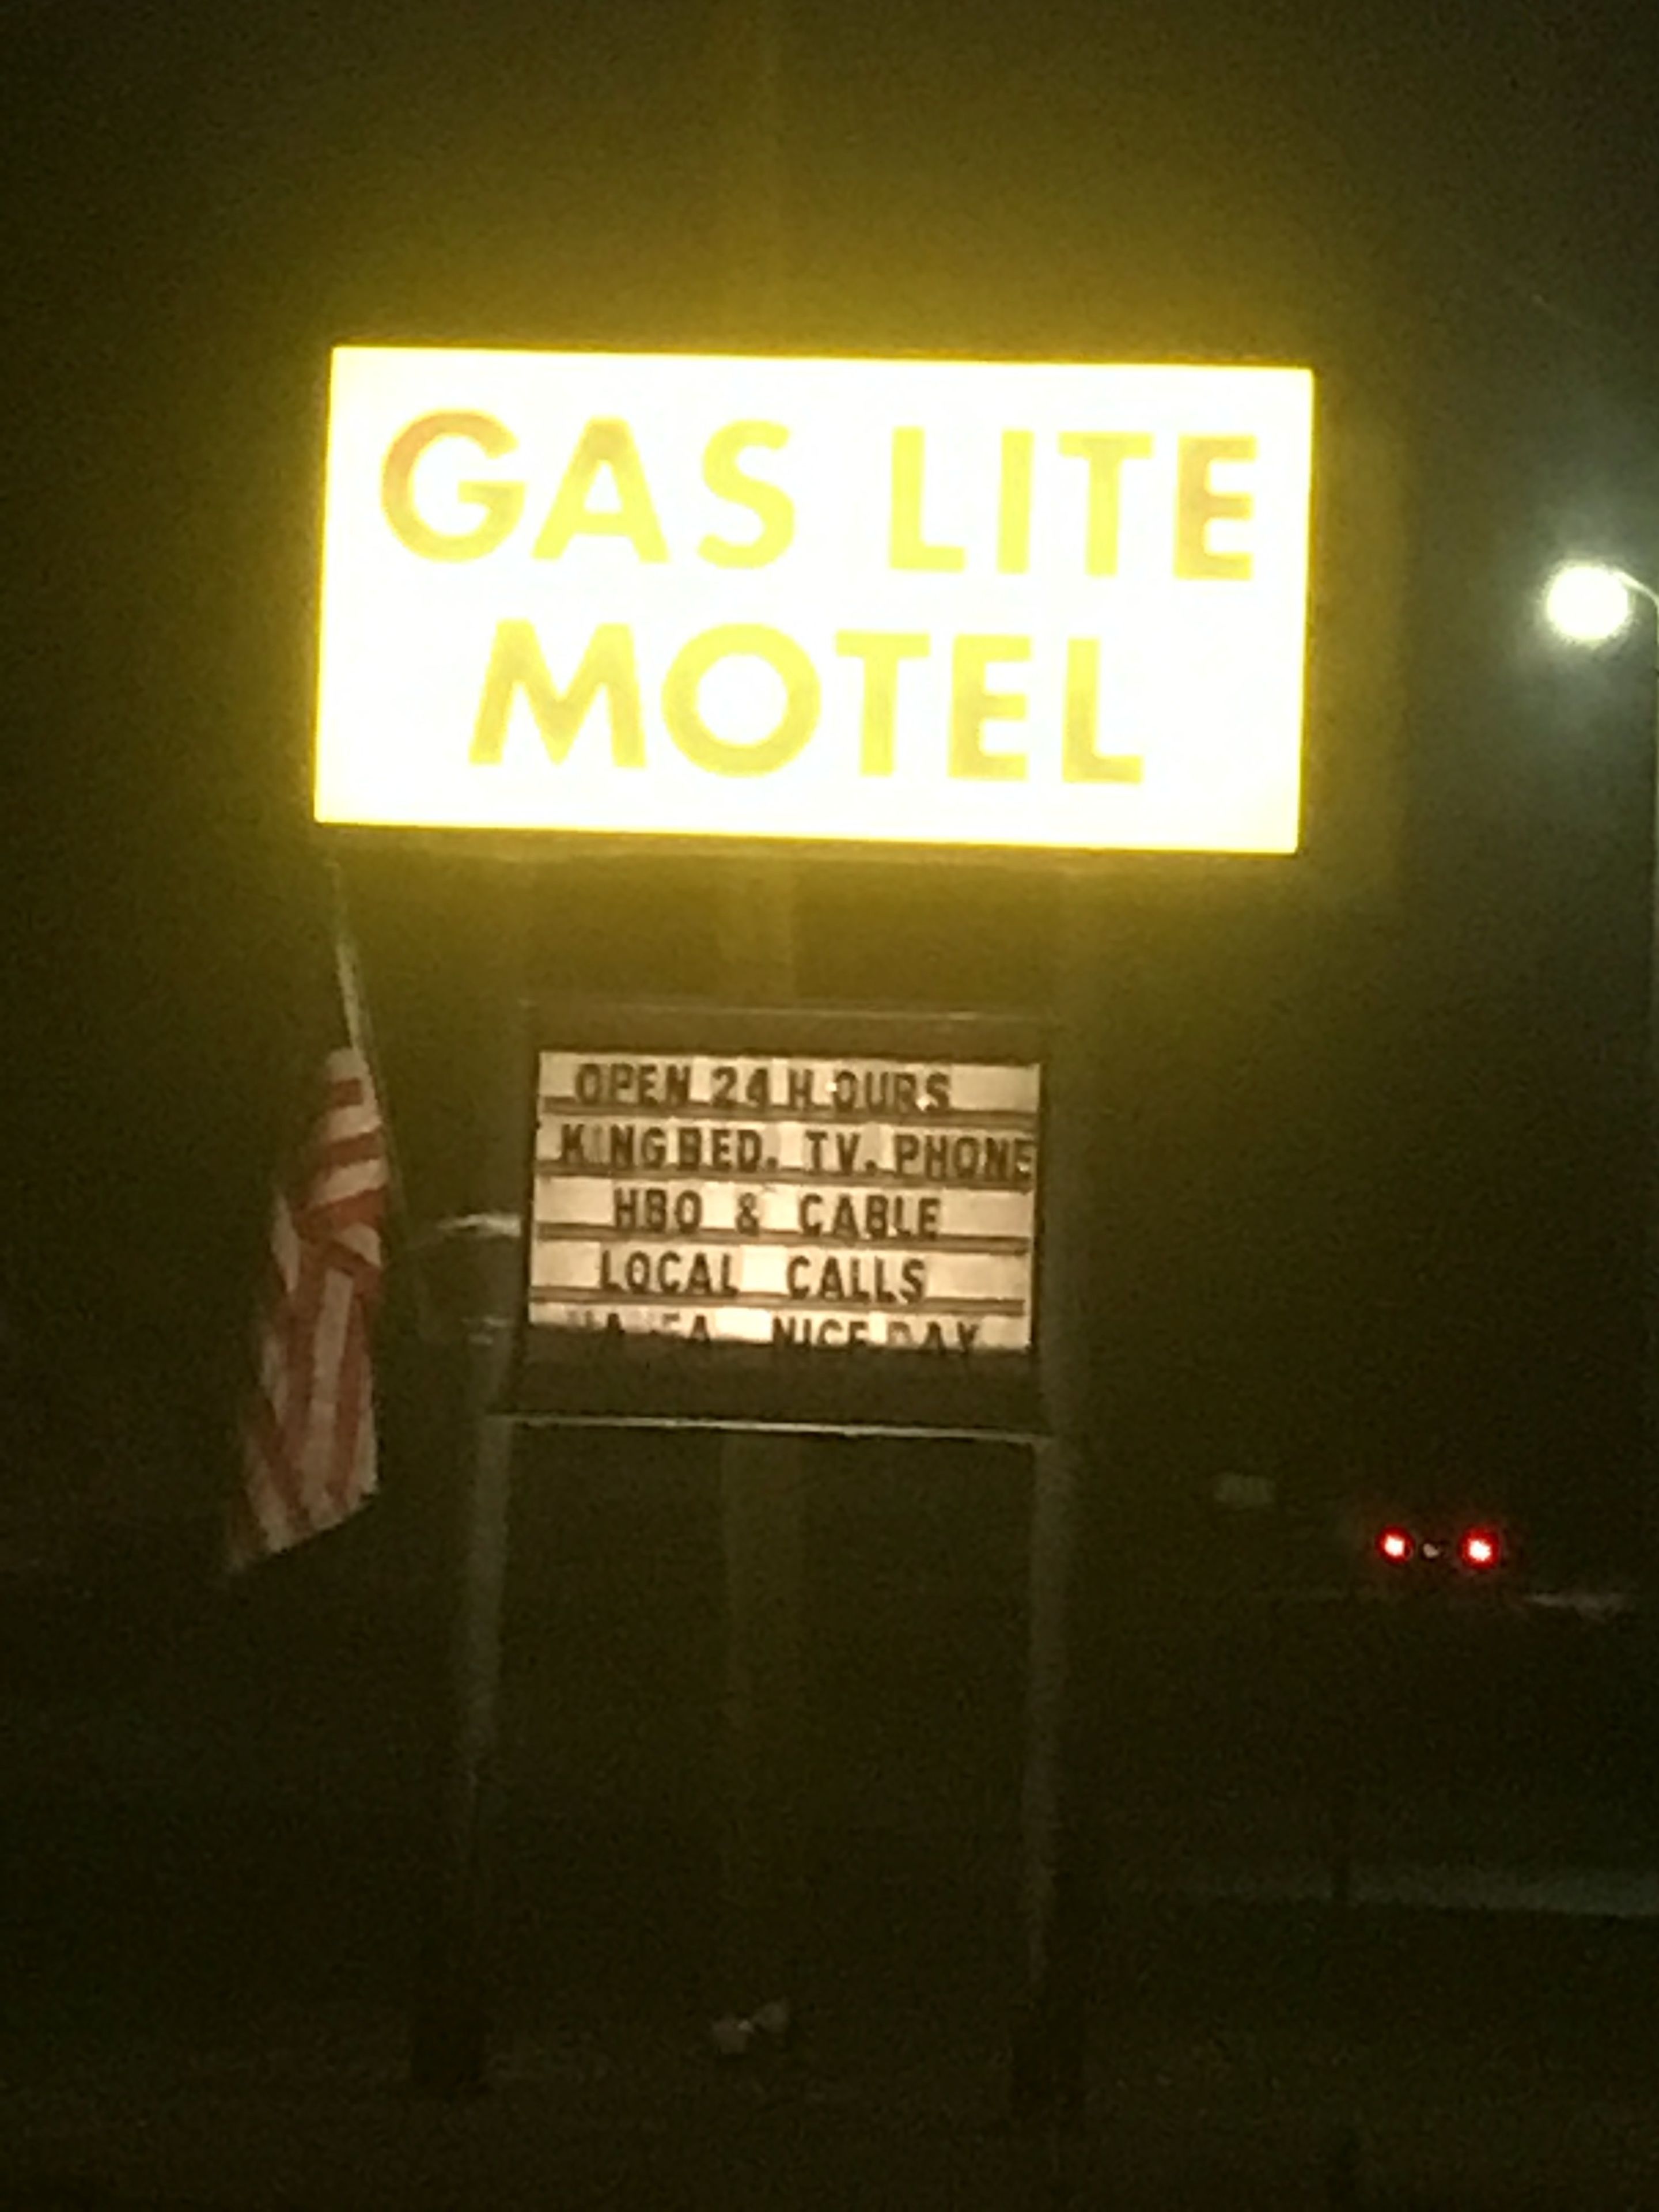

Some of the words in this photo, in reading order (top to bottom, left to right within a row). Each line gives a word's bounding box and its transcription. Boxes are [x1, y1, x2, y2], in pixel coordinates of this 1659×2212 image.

[380, 408, 796, 570] GAS
[888, 426, 1258, 581] LITE
[468, 619, 1144, 786] MOTEL
[576, 1063, 691, 1107] OPEN
[712, 1067, 770, 1109] 24
[894, 1133, 1035, 1181] PHONE
[613, 1188, 702, 1234] HBO
[737, 1192, 760, 1236] &
[800, 1193, 941, 1240] CABLE
[601, 1249, 739, 1296] LOCAL
[787, 1255, 925, 1303] CALLS
